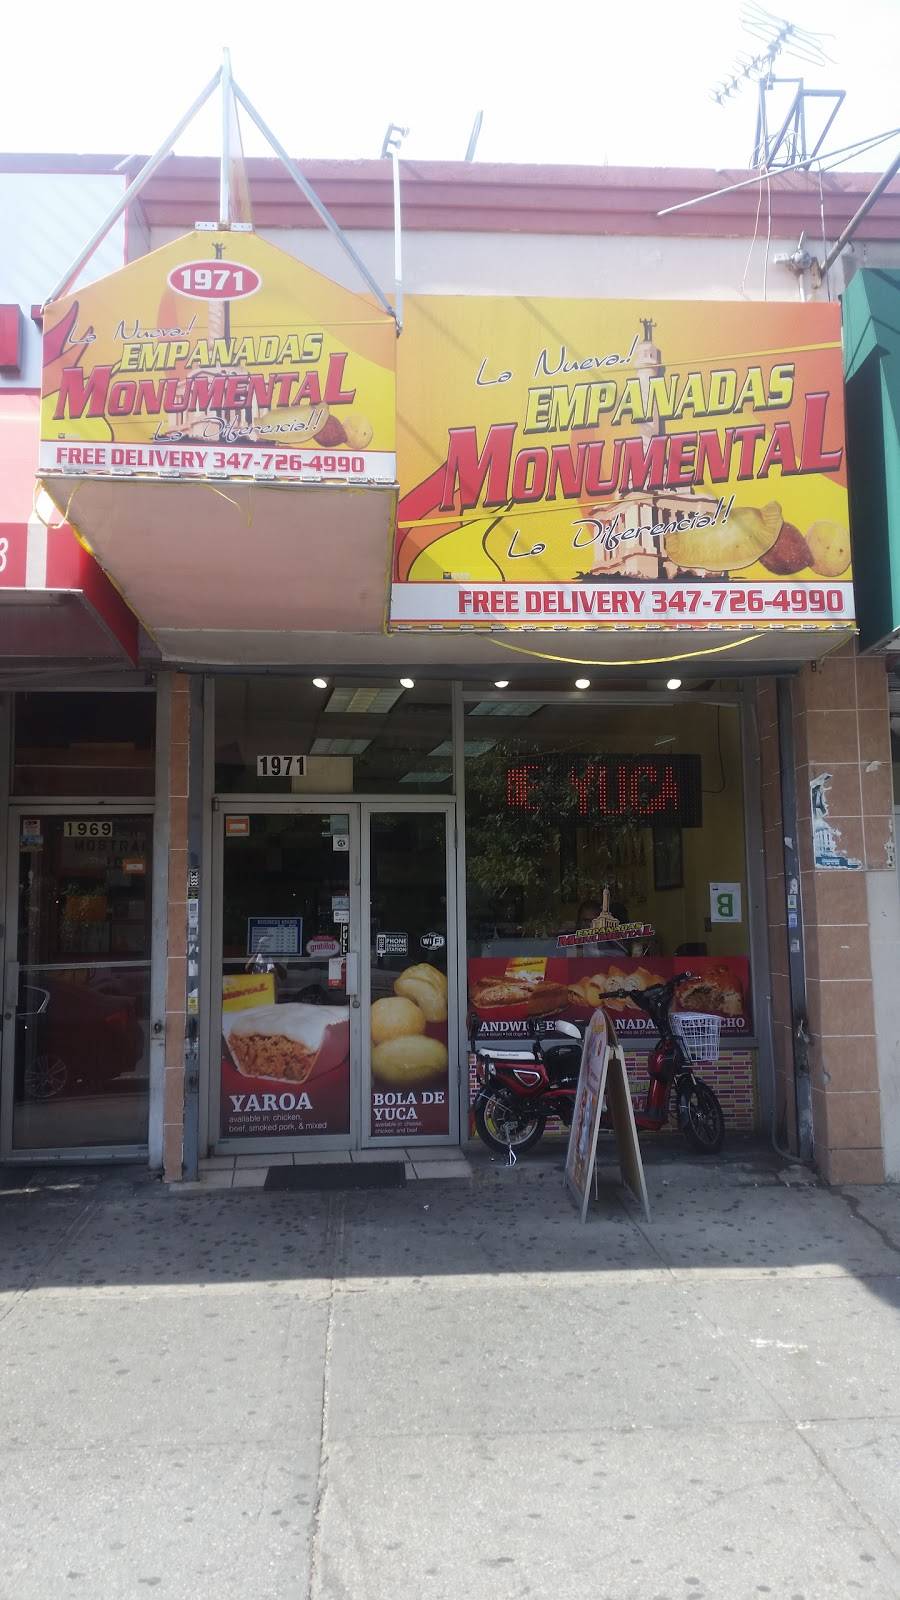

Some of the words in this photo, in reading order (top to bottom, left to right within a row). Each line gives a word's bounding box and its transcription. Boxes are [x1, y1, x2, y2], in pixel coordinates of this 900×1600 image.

[180, 269, 244, 291] 1971
[119, 332, 323, 373] EMPANADAS
[476, 358, 512, 386] La
[53, 352, 356, 420] MONUMENTAL
[523, 362, 795, 436] EMPANADAS
[56, 447, 106, 466] FREE
[111, 448, 207, 468] DELIVERY
[214, 452, 365, 473] 347-726-4990
[438, 391, 843, 512] MONUMENTAL
[507, 529, 546, 558] La
[458, 590, 520, 614] FREE
[525, 590, 647, 614] DELIVERY
[652, 589, 844, 614] 347-726-4990
[259, 756, 305, 776] 1971
[570, 765, 680, 815] YUCA
[67, 822, 112, 836] 1969
[575, 922, 643, 937] EMPANADAS
[229, 1092, 313, 1113] YAROA
[373, 1092, 418, 1106] BOLA
[422, 1091, 445, 1104] DE
[229, 1114, 261, 1123] available
[373, 1107, 418, 1121] YUCA
[248, 1123, 278, 1132] smoked
[298, 1121, 304, 1130] &
[305, 1121, 328, 1130] mixed
